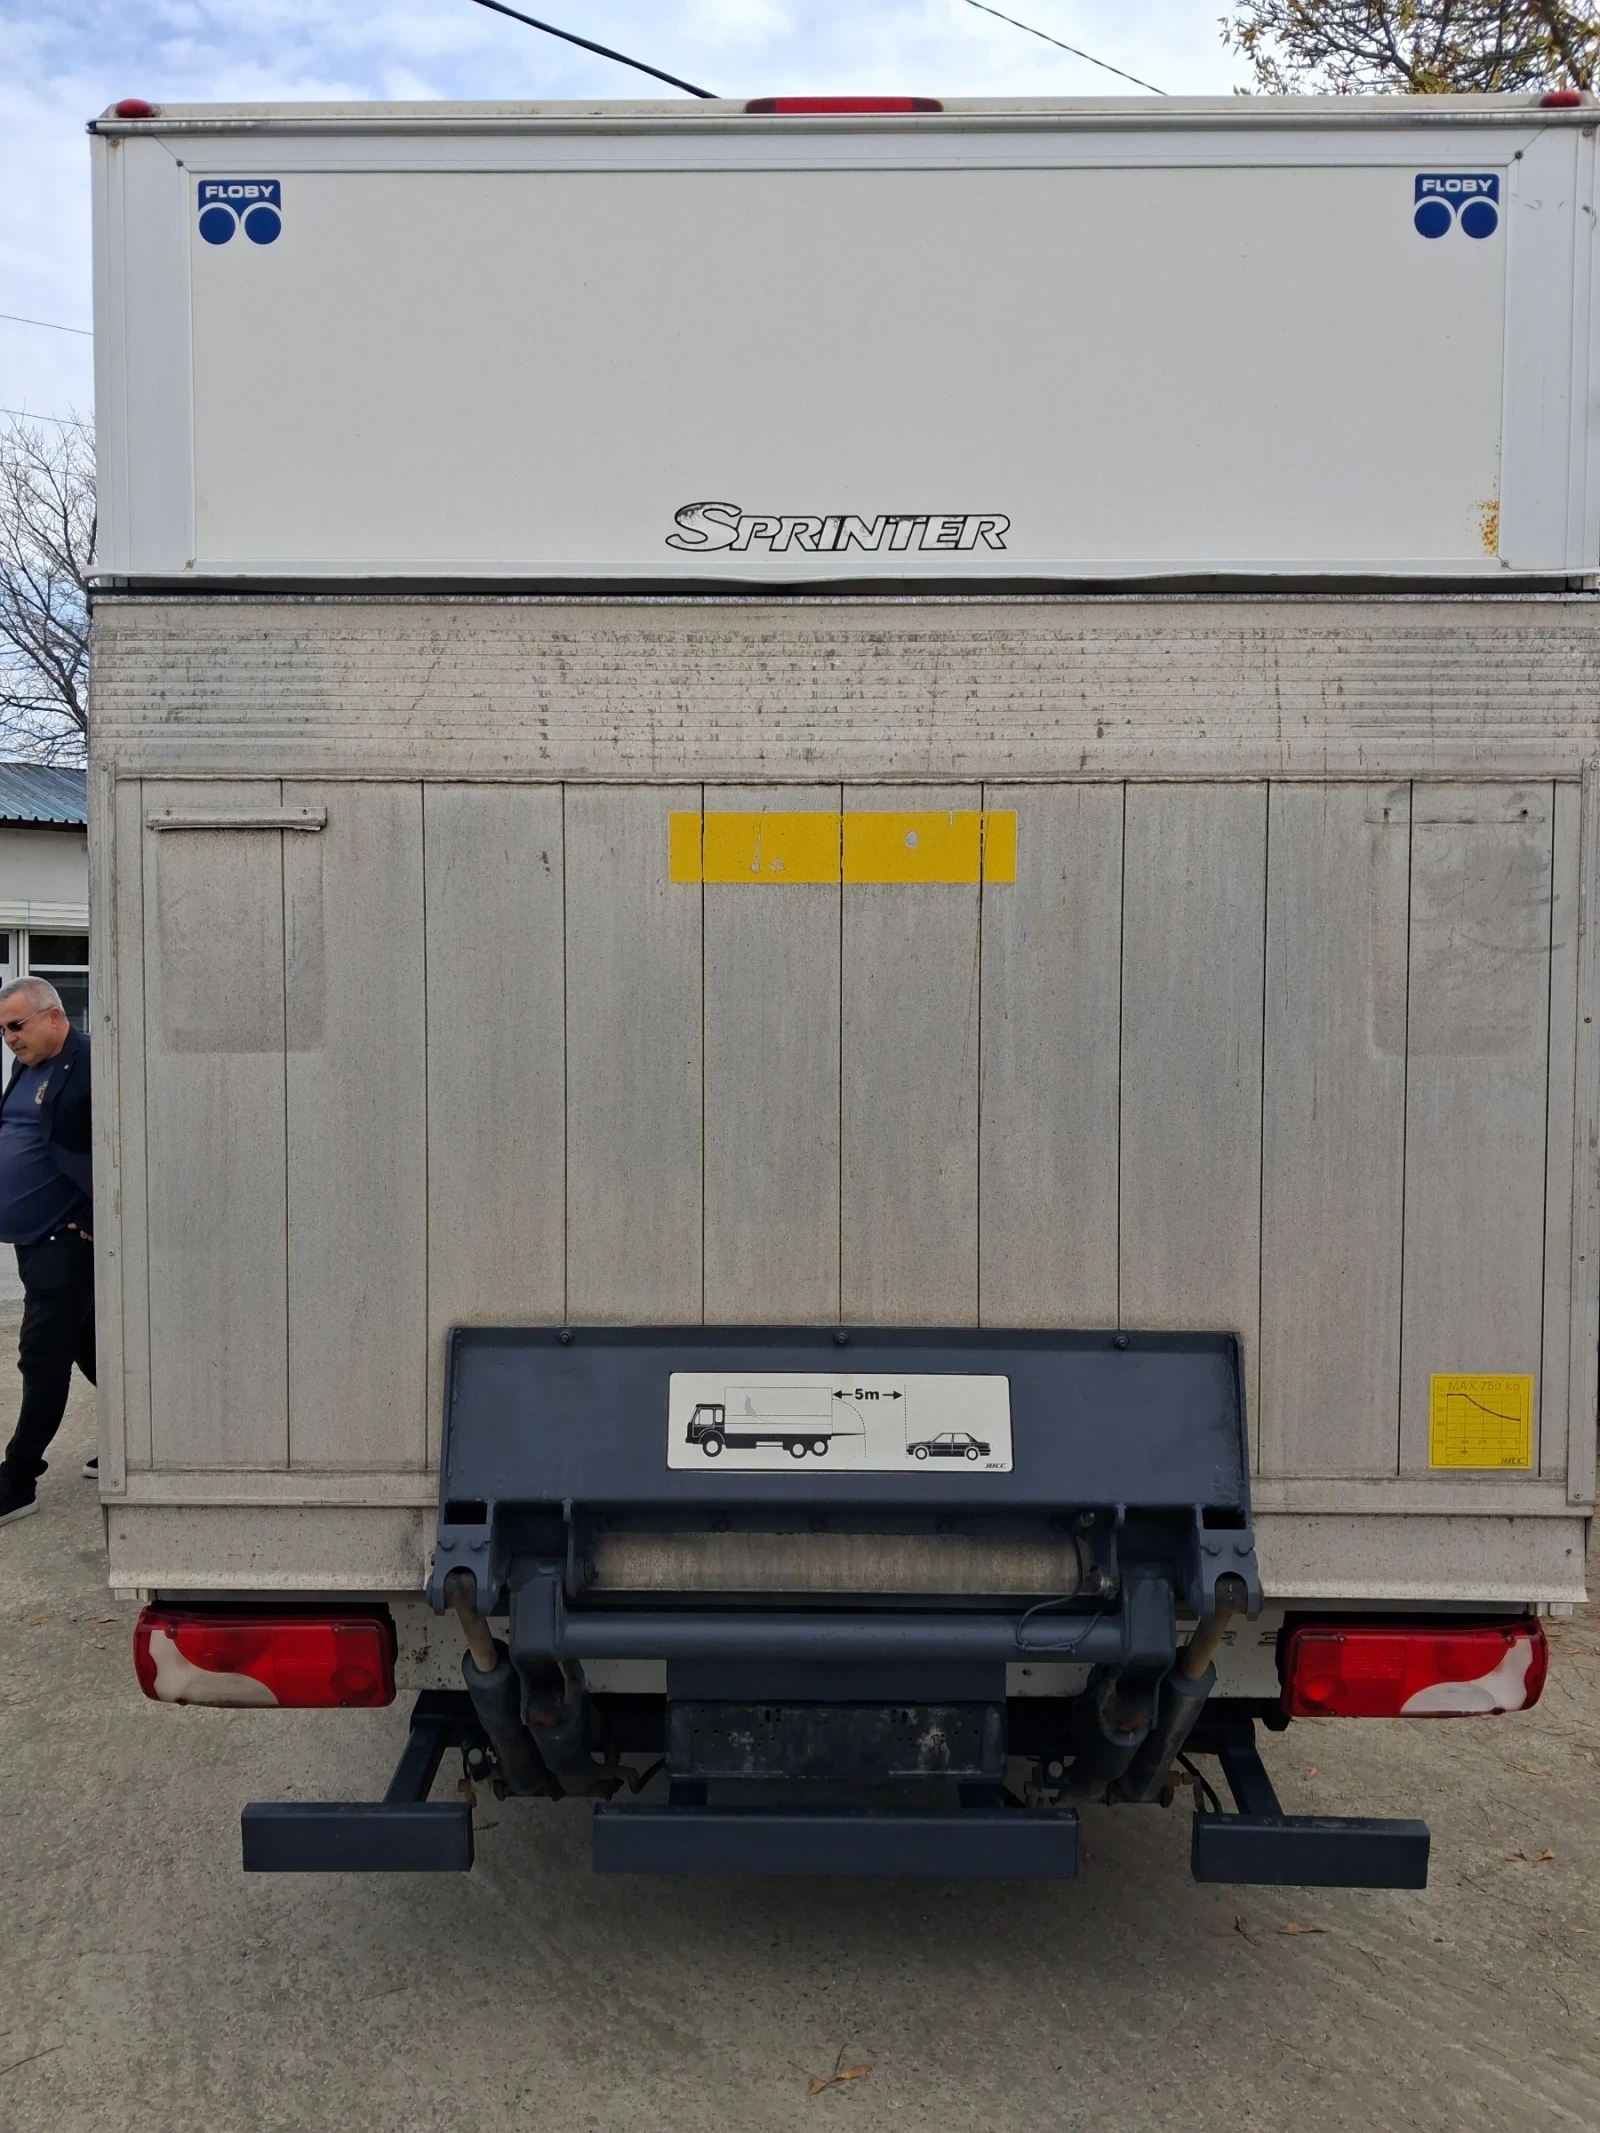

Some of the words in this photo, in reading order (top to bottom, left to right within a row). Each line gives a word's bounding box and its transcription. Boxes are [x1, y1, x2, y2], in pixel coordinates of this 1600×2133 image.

[205, 185, 274, 198] FLOBY
[1422, 179, 1493, 192] FLOBY
[665, 501, 1011, 552] SPRINTER
[1448, 1381, 1477, 1391] MAX
[1480, 1381, 1502, 1391] 750
[854, 1388, 880, 1401] 5m
